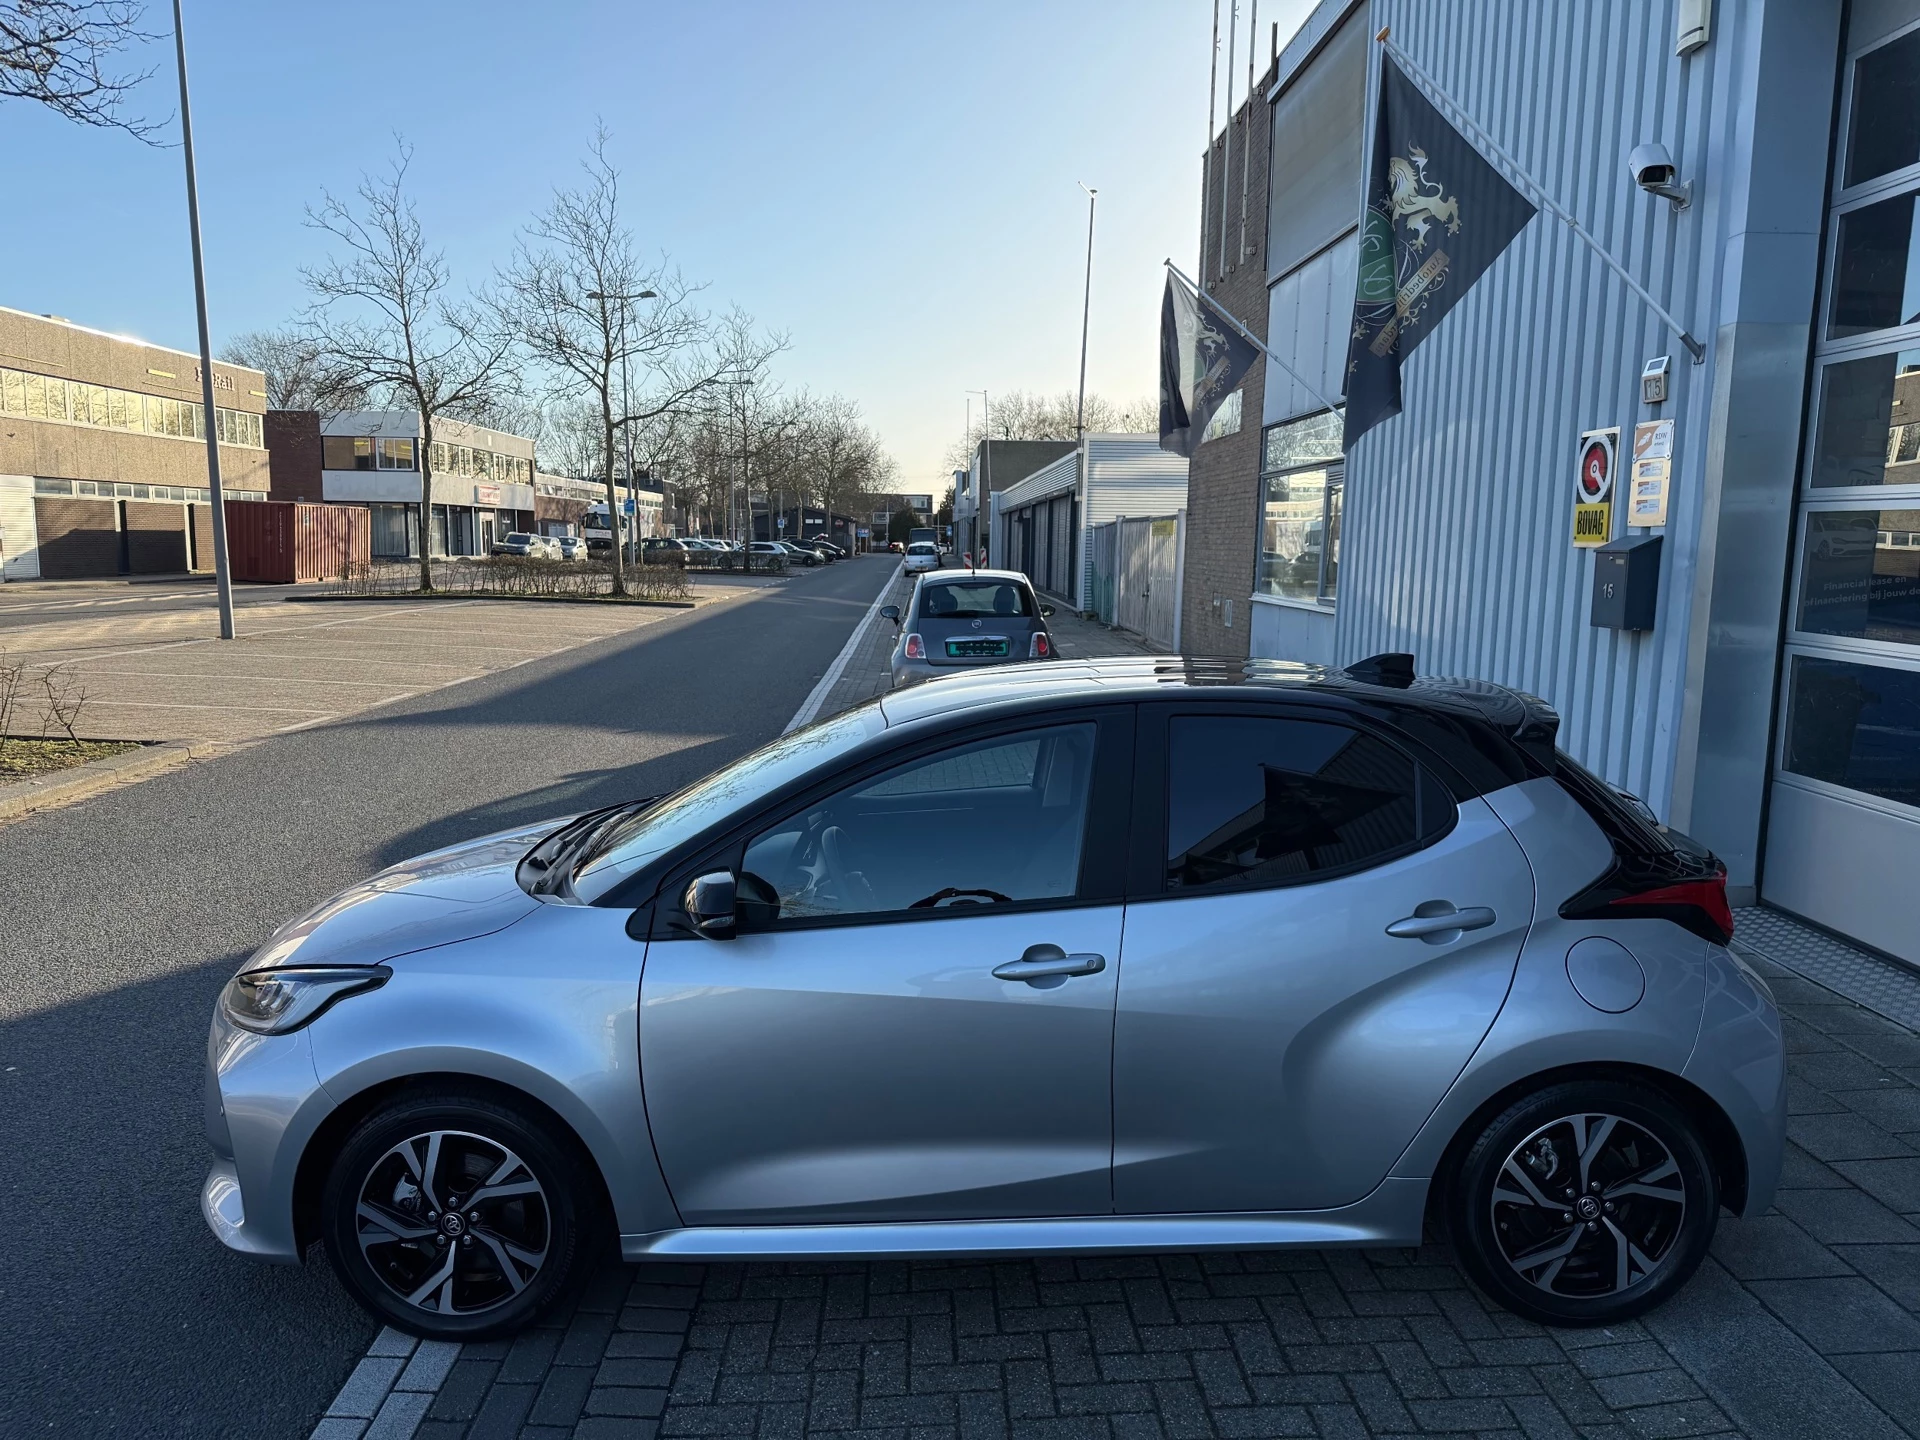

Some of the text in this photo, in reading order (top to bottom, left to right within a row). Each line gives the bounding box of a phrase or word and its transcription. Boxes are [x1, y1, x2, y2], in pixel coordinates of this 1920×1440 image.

[1647, 380, 1661, 398] 15
[1577, 509, 1604, 535] BOVAG
[1602, 583, 1614, 599] 15
[1823, 578, 1867, 591] Financial
[1868, 577, 1892, 588] lease
[1870, 590, 1881, 600] bij
[1883, 588, 1907, 600] jouw
